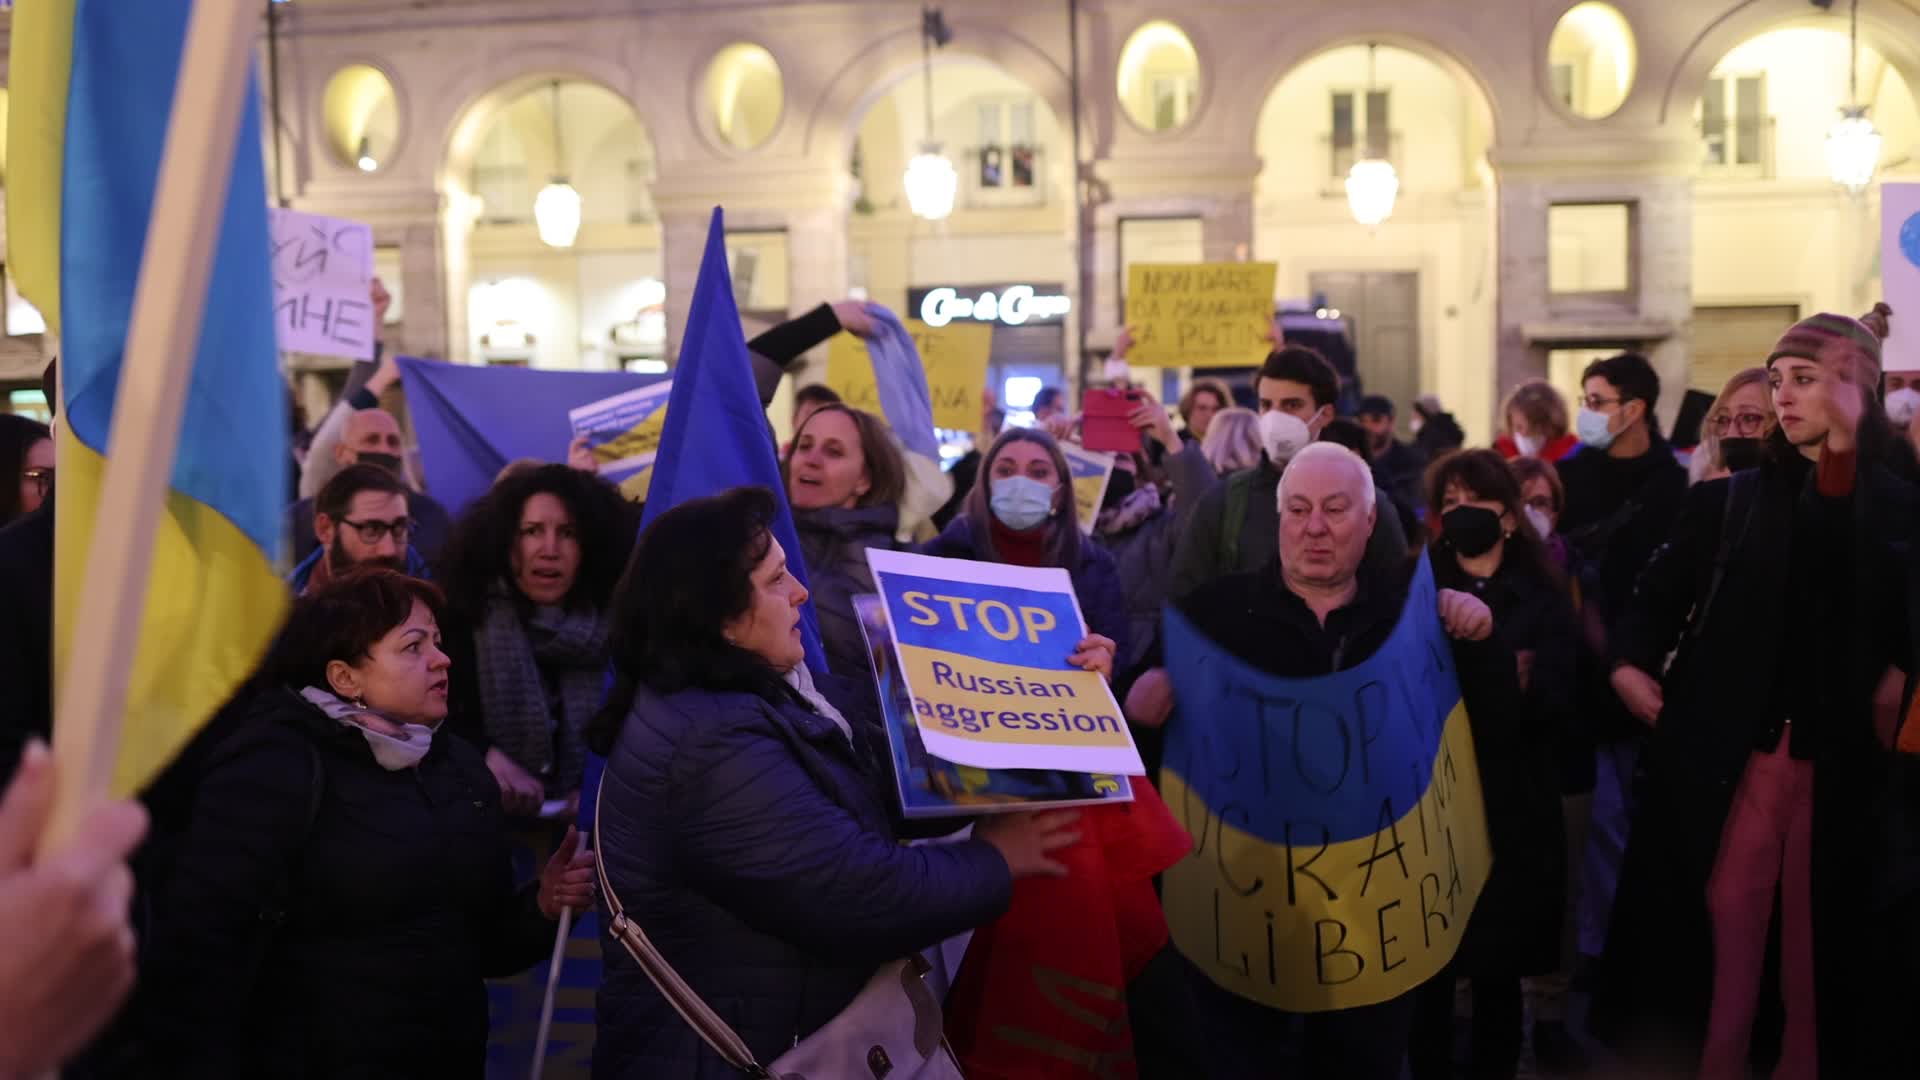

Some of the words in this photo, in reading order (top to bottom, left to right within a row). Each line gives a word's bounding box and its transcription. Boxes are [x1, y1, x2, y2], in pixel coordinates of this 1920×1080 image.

[902, 590, 1057, 644] STOP
[931, 661, 1076, 698] Russian
[914, 697, 1121, 734] aggression
[1198, 656, 1388, 797] STOP
[1183, 722, 1458, 906] UCRAINA
